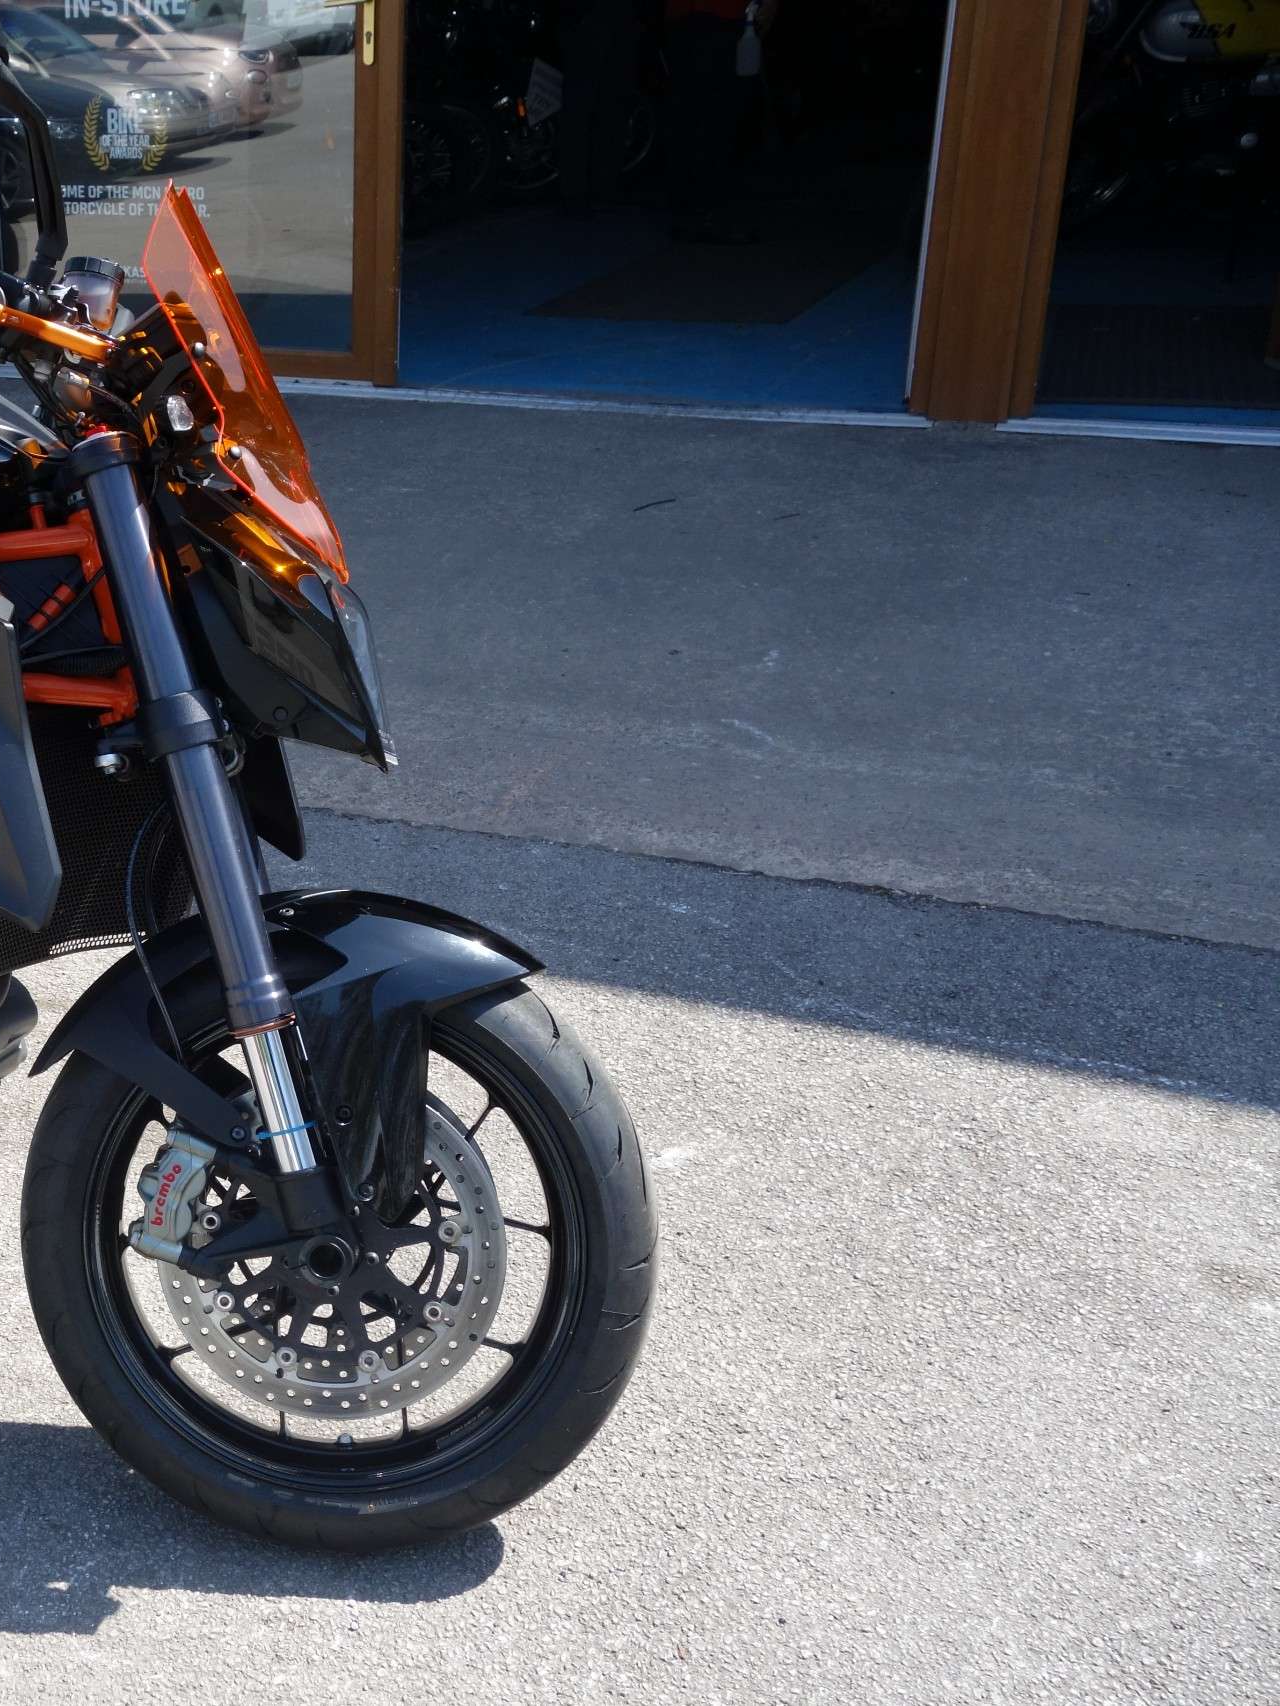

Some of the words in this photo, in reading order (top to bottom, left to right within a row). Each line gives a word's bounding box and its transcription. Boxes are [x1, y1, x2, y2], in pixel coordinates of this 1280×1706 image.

[107, 108, 145, 134] BIKE
[109, 147, 144, 159] AWARDS
[61, 184, 85, 198] OME
[88, 185, 103, 198] OF
[105, 185, 129, 198] THE
[132, 186, 161, 200] MCN
[64, 201, 125, 216] TORCYCLE
[128, 203, 144, 216] OF
[150, 1164, 182, 1226] brembo
